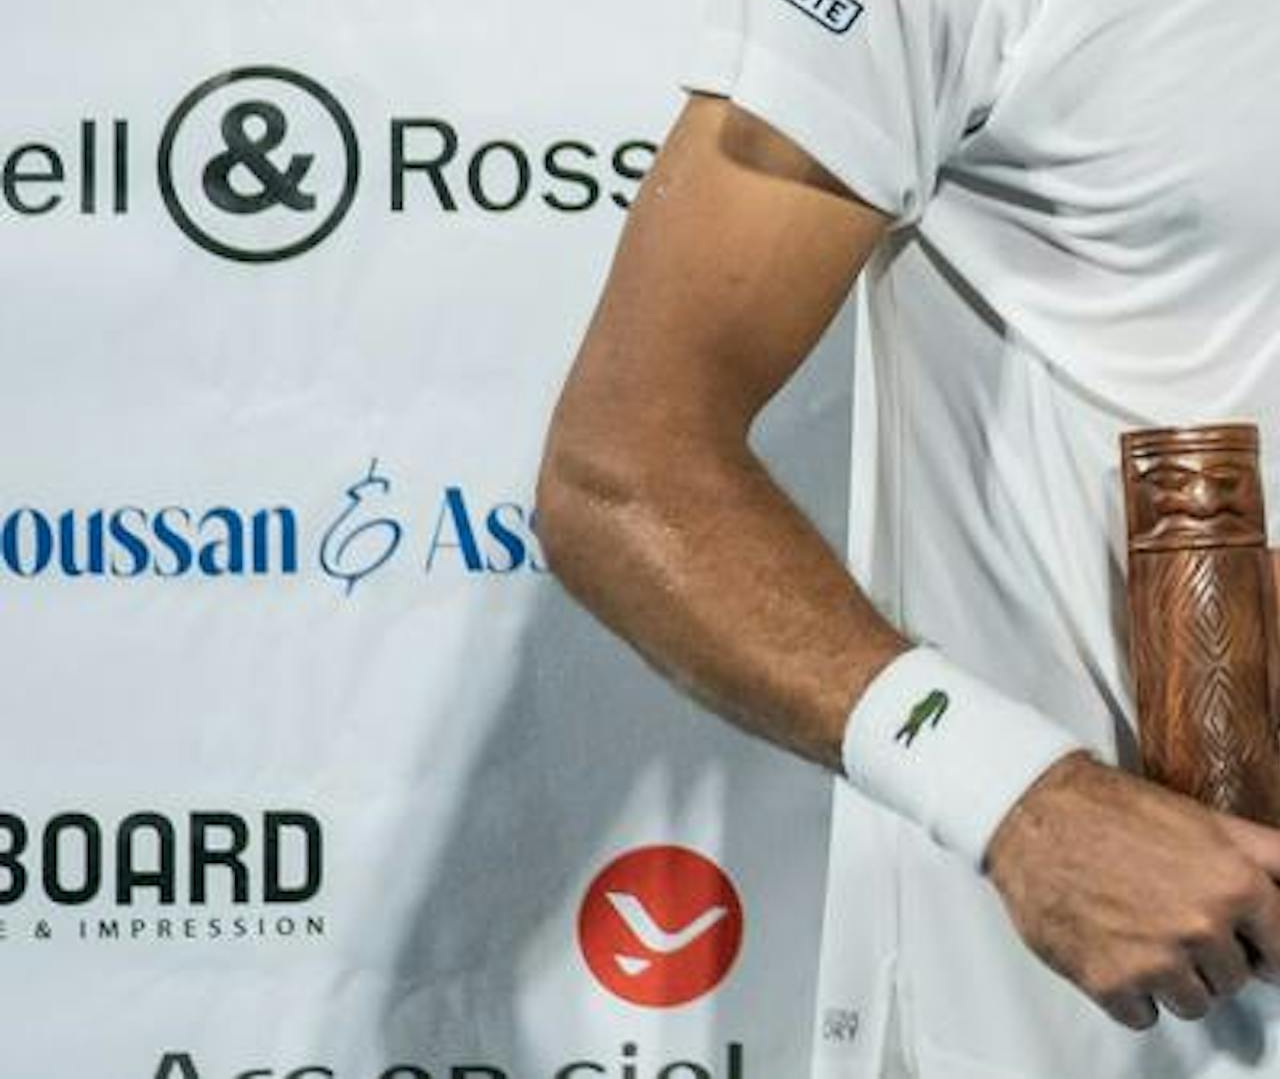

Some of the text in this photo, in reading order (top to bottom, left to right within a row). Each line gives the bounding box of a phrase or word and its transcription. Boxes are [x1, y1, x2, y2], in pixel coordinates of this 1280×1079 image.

[201, 99, 318, 215] &
[34, 915, 326, 939] & IMPRESSION
